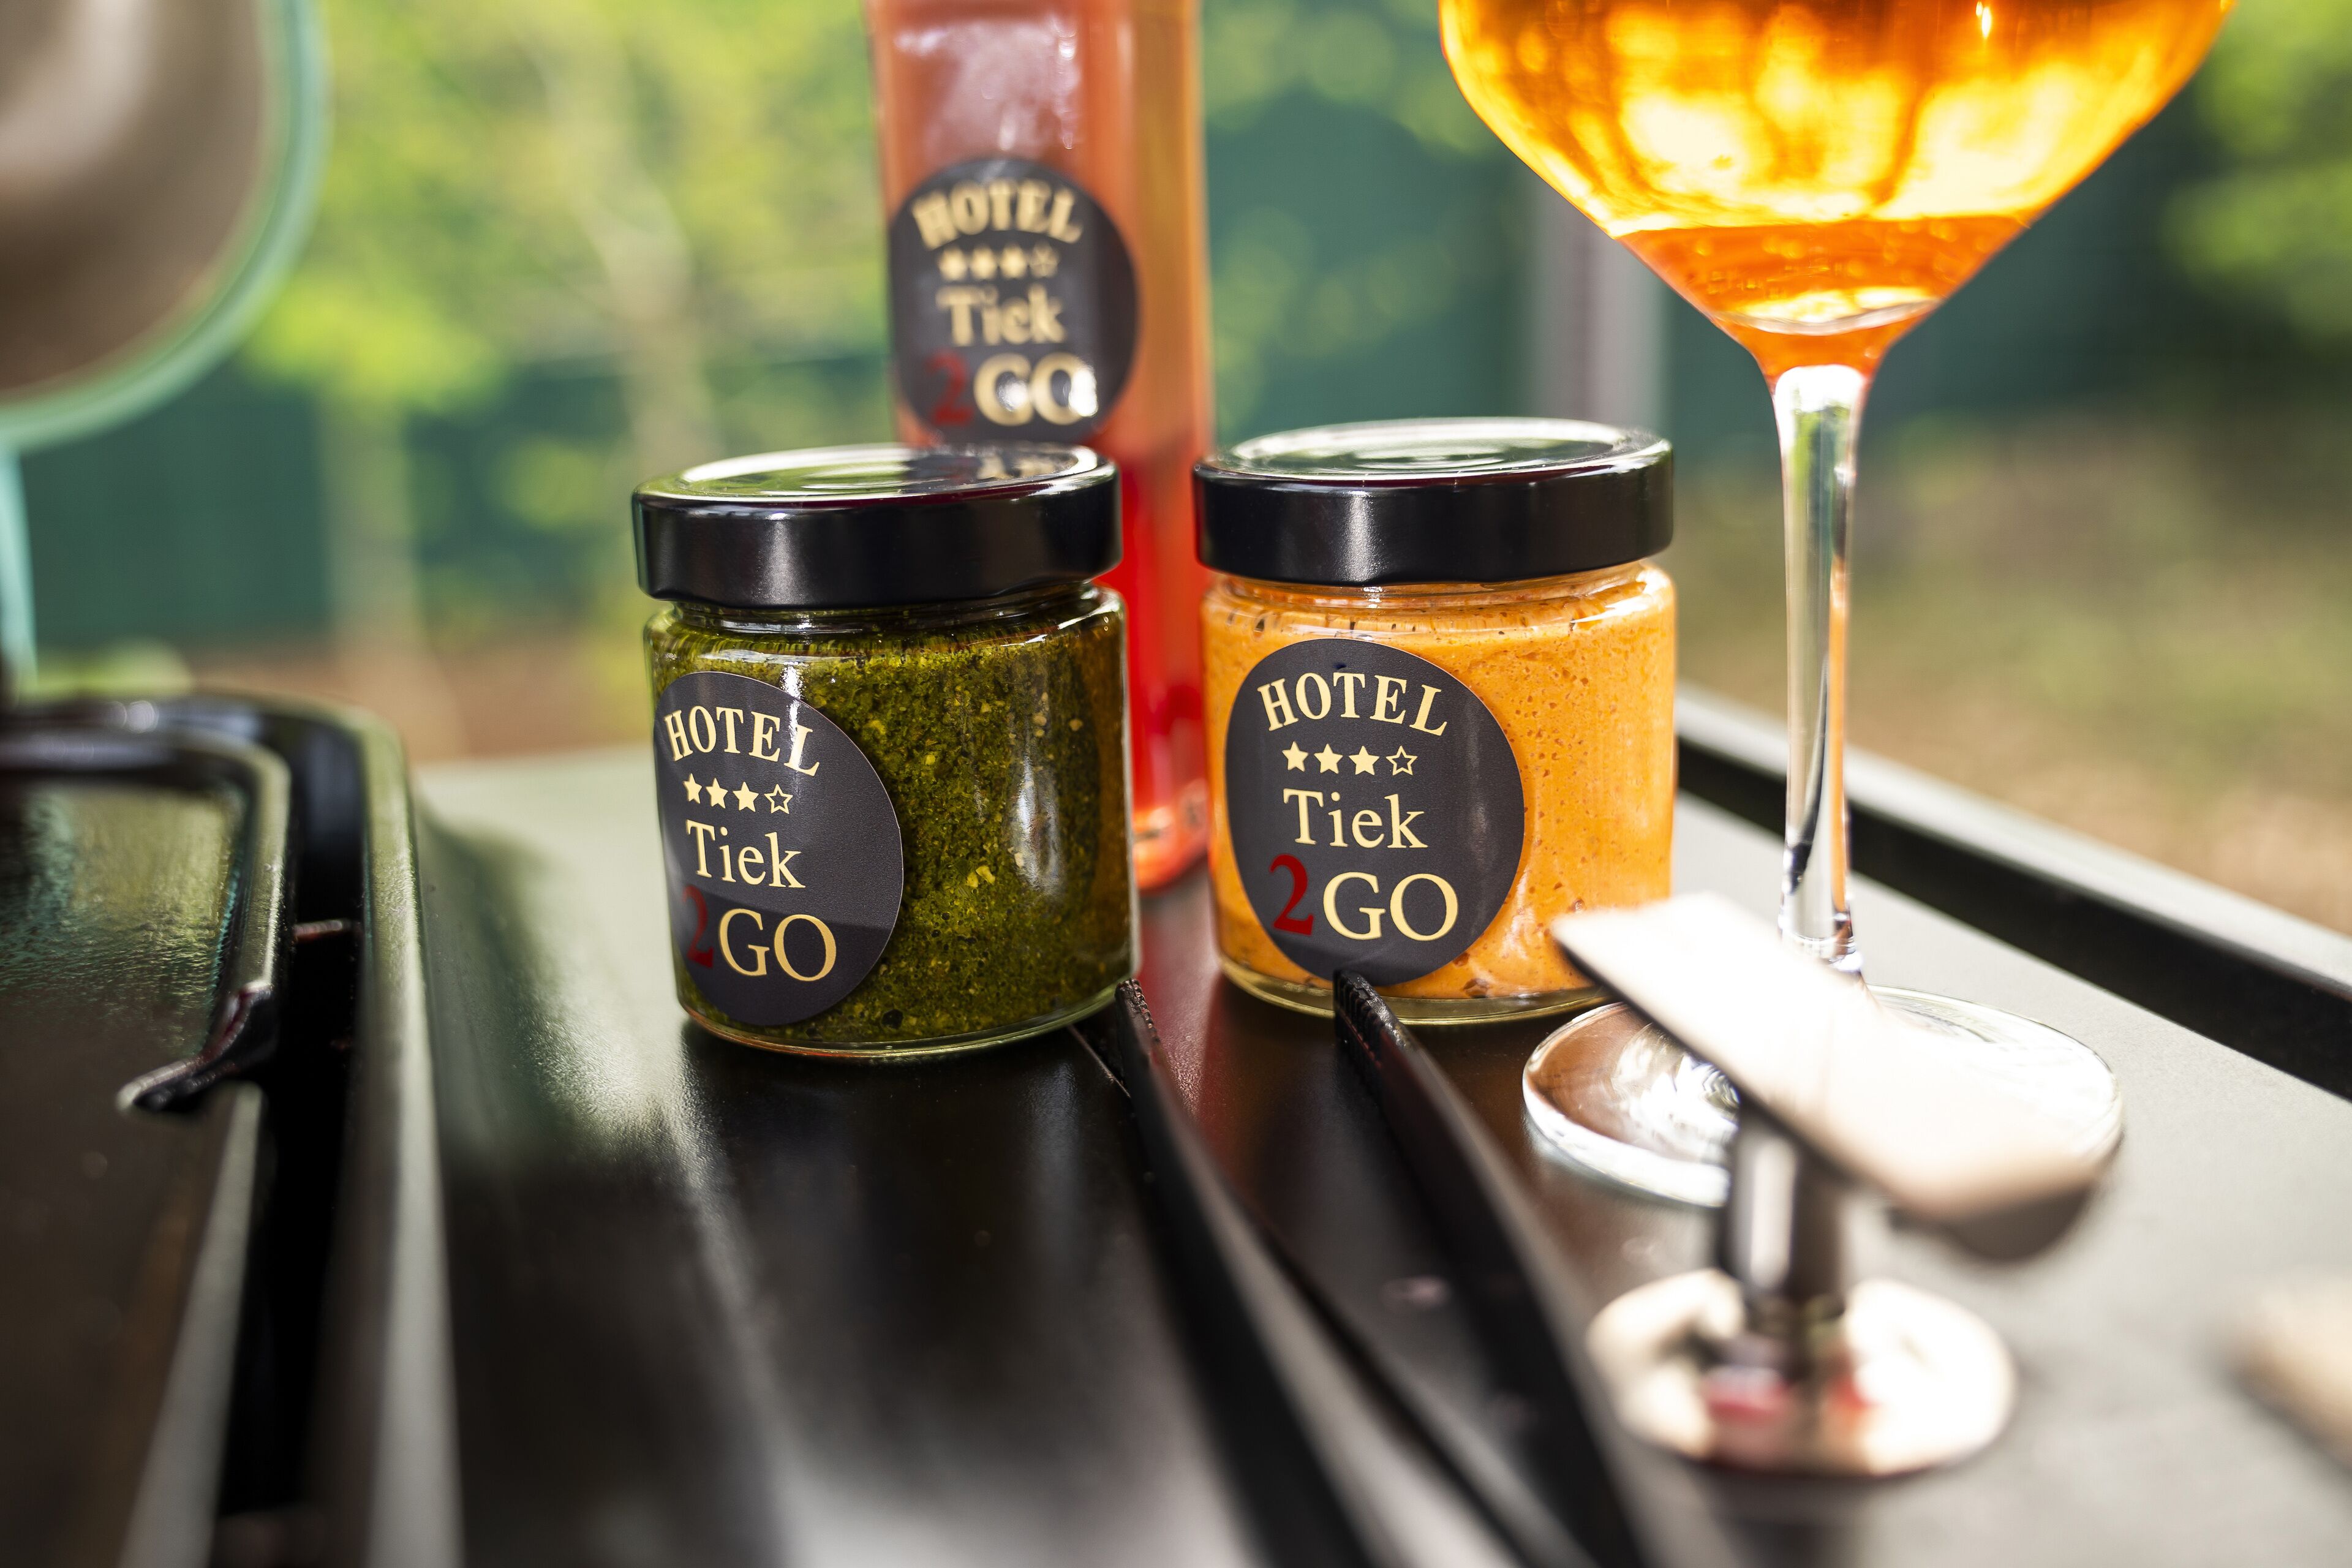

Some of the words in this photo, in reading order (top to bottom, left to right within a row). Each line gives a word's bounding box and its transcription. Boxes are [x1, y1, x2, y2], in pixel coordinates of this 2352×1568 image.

[912, 178, 1082, 250] HOTEL
[935, 284, 1065, 346] Tiek
[1257, 672, 1447, 736] HOTEL
[664, 706, 820, 776] HOTEL
[1283, 788, 1428, 849] Tiek
[685, 819, 806, 888] Tiek
[1268, 853, 1458, 941] 2GO
[682, 885, 837, 982] 2GO
